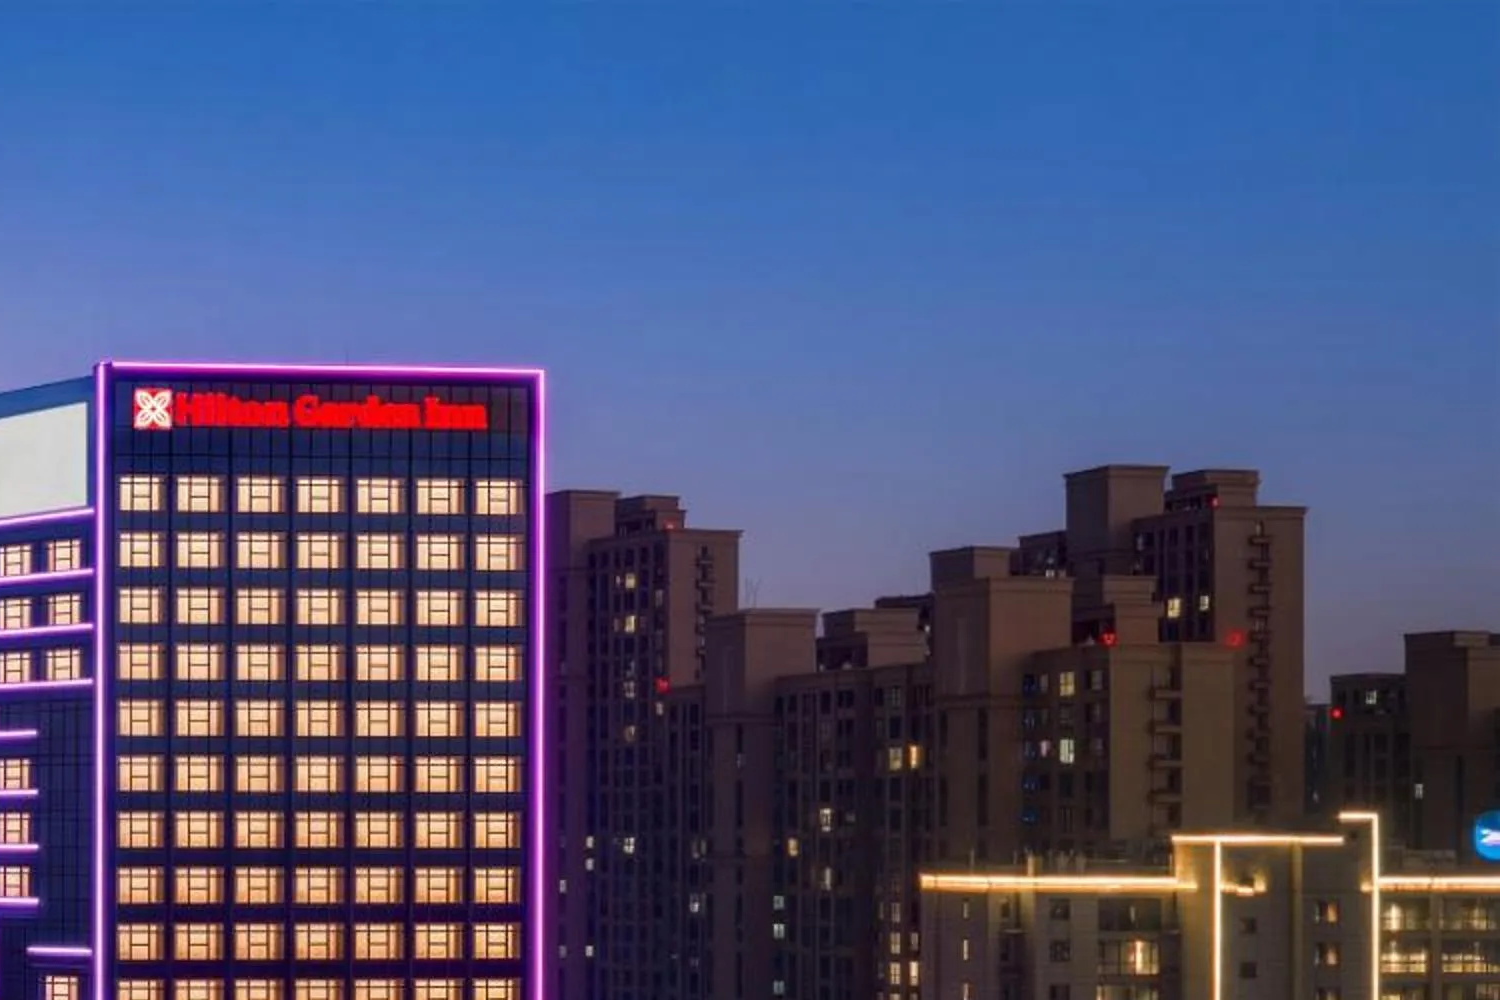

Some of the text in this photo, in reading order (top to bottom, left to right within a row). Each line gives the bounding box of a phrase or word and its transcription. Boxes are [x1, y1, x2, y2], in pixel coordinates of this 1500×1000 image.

[175, 392, 488, 430] Hilton Garden Inn
